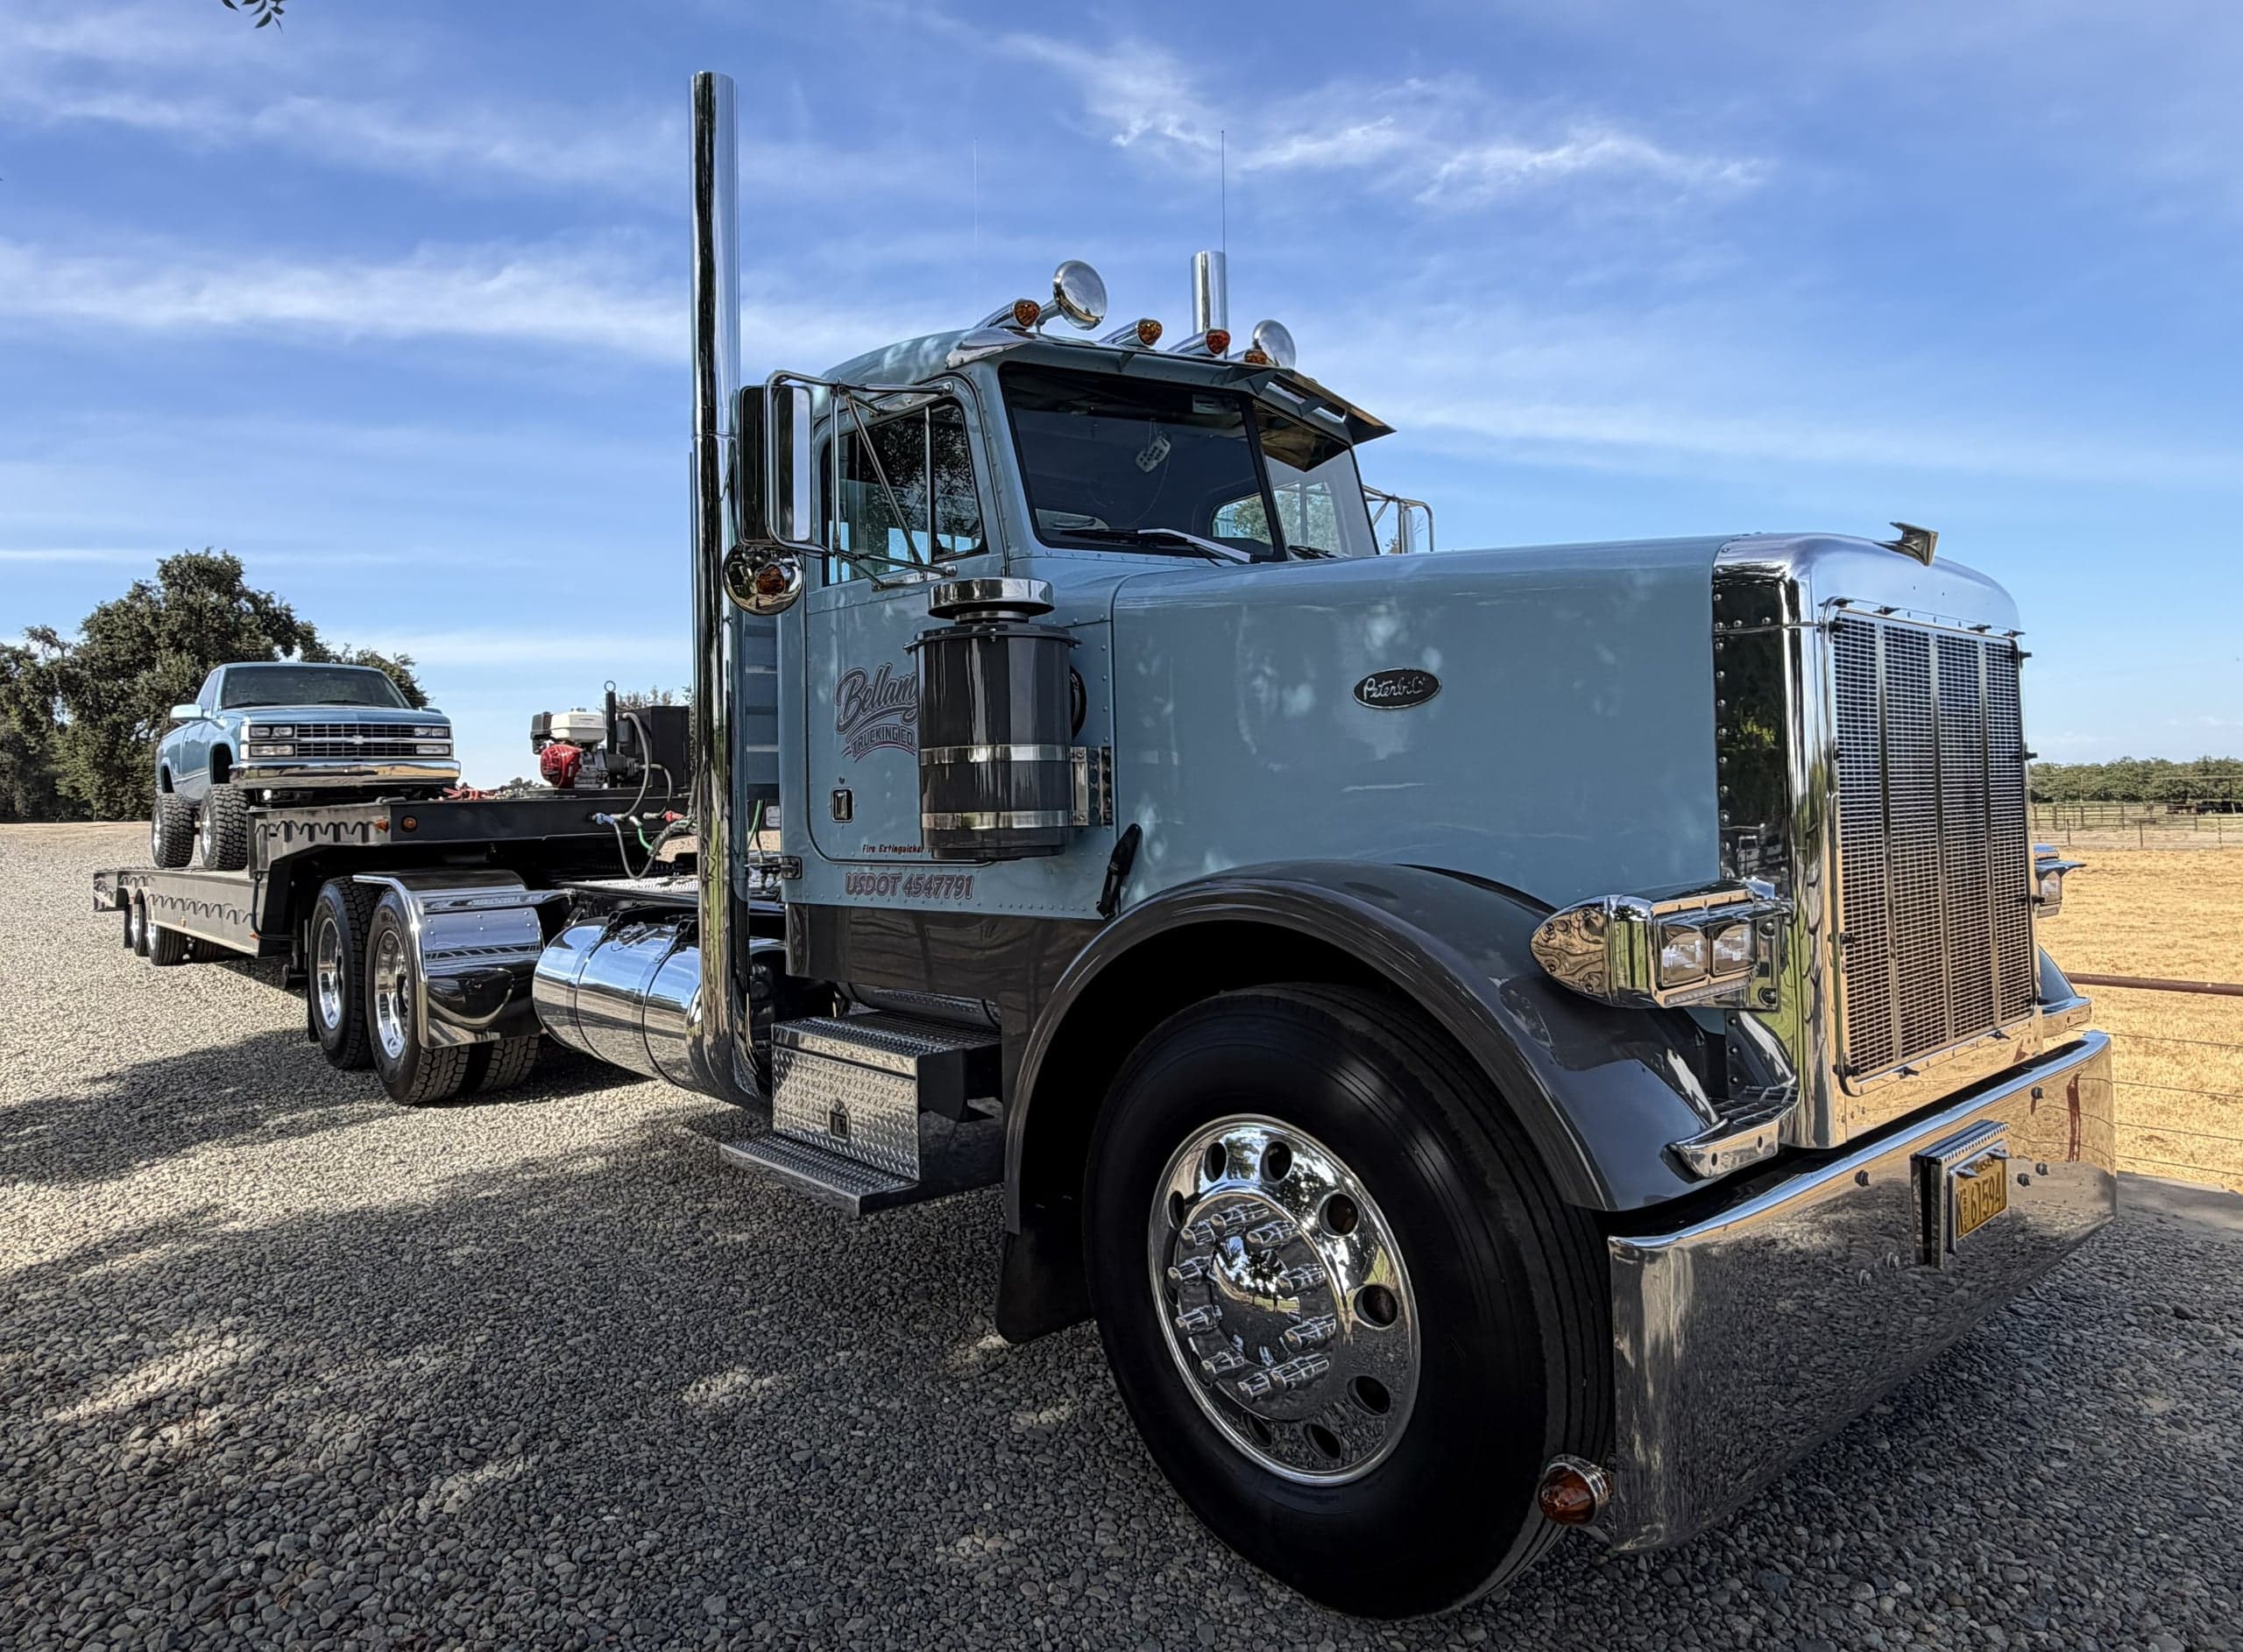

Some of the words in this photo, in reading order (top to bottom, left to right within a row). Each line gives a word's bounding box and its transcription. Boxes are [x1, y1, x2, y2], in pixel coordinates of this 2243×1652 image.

[852, 725, 898, 755] TRUCKING
[862, 844, 875, 853] Fire
[846, 872, 902, 897] USDOT
[902, 873, 974, 900] 4547791
